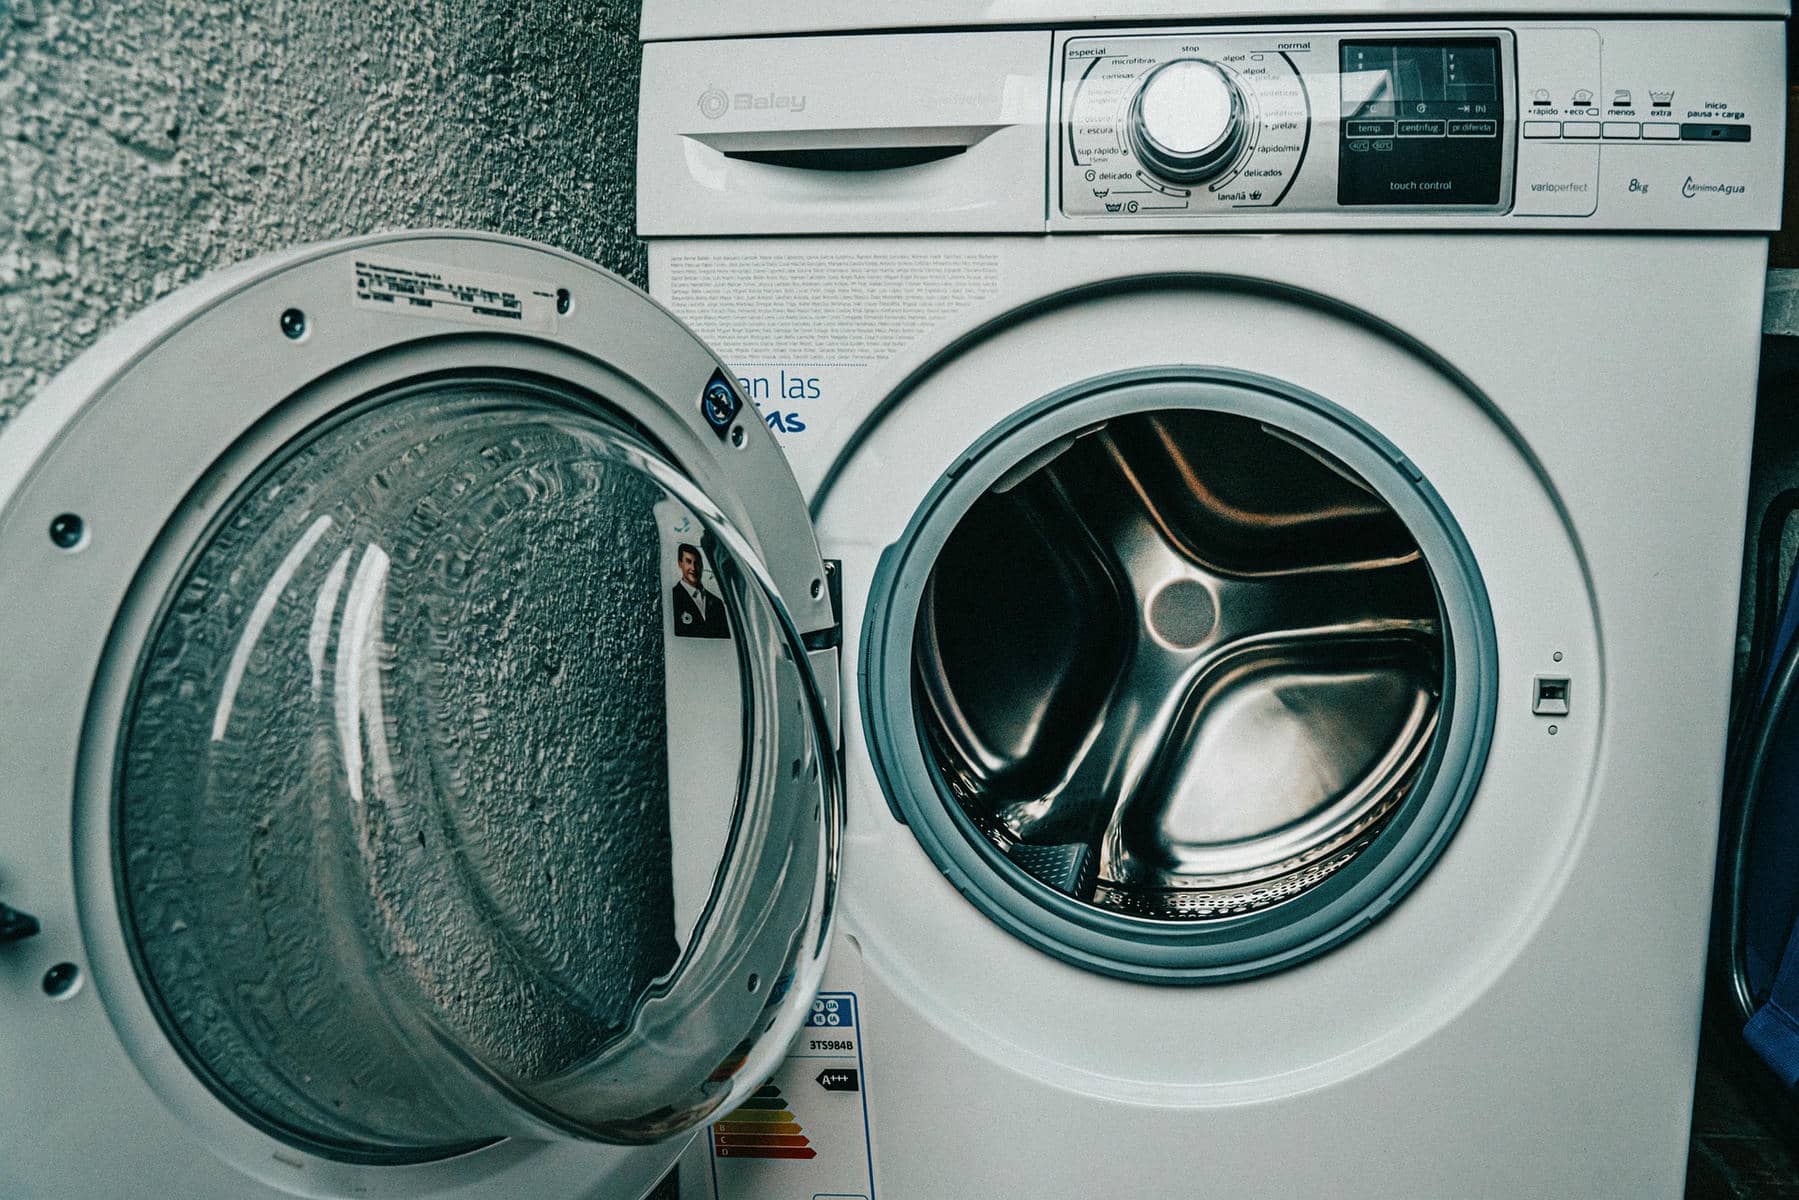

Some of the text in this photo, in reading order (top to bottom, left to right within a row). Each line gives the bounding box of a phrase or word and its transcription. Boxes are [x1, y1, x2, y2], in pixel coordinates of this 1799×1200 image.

[1181, 45, 1200, 53] stop
[1277, 42, 1311, 50] normal
[1069, 48, 1106, 57] especial
[734, 92, 807, 113] Balay
[1704, 102, 1728, 110] inicio
[1533, 107, 1559, 116] rápido
[1607, 109, 1636, 117] menos
[1687, 111, 1713, 119] pausa
[1721, 112, 1745, 120] carga
[1099, 172, 1132, 180] delicado
[1244, 169, 1282, 177] delicados
[1390, 181, 1452, 190] touch control
[1531, 182, 1588, 193] varioperfect
[1628, 178, 1649, 194] 8kg
[781, 370, 820, 399] las
[809, 1040, 853, 1050] 3TS984B
[822, 1074, 849, 1085] A+++
[719, 1124, 726, 1132] B
[720, 1136, 727, 1144] C
[721, 1148, 729, 1156] D
